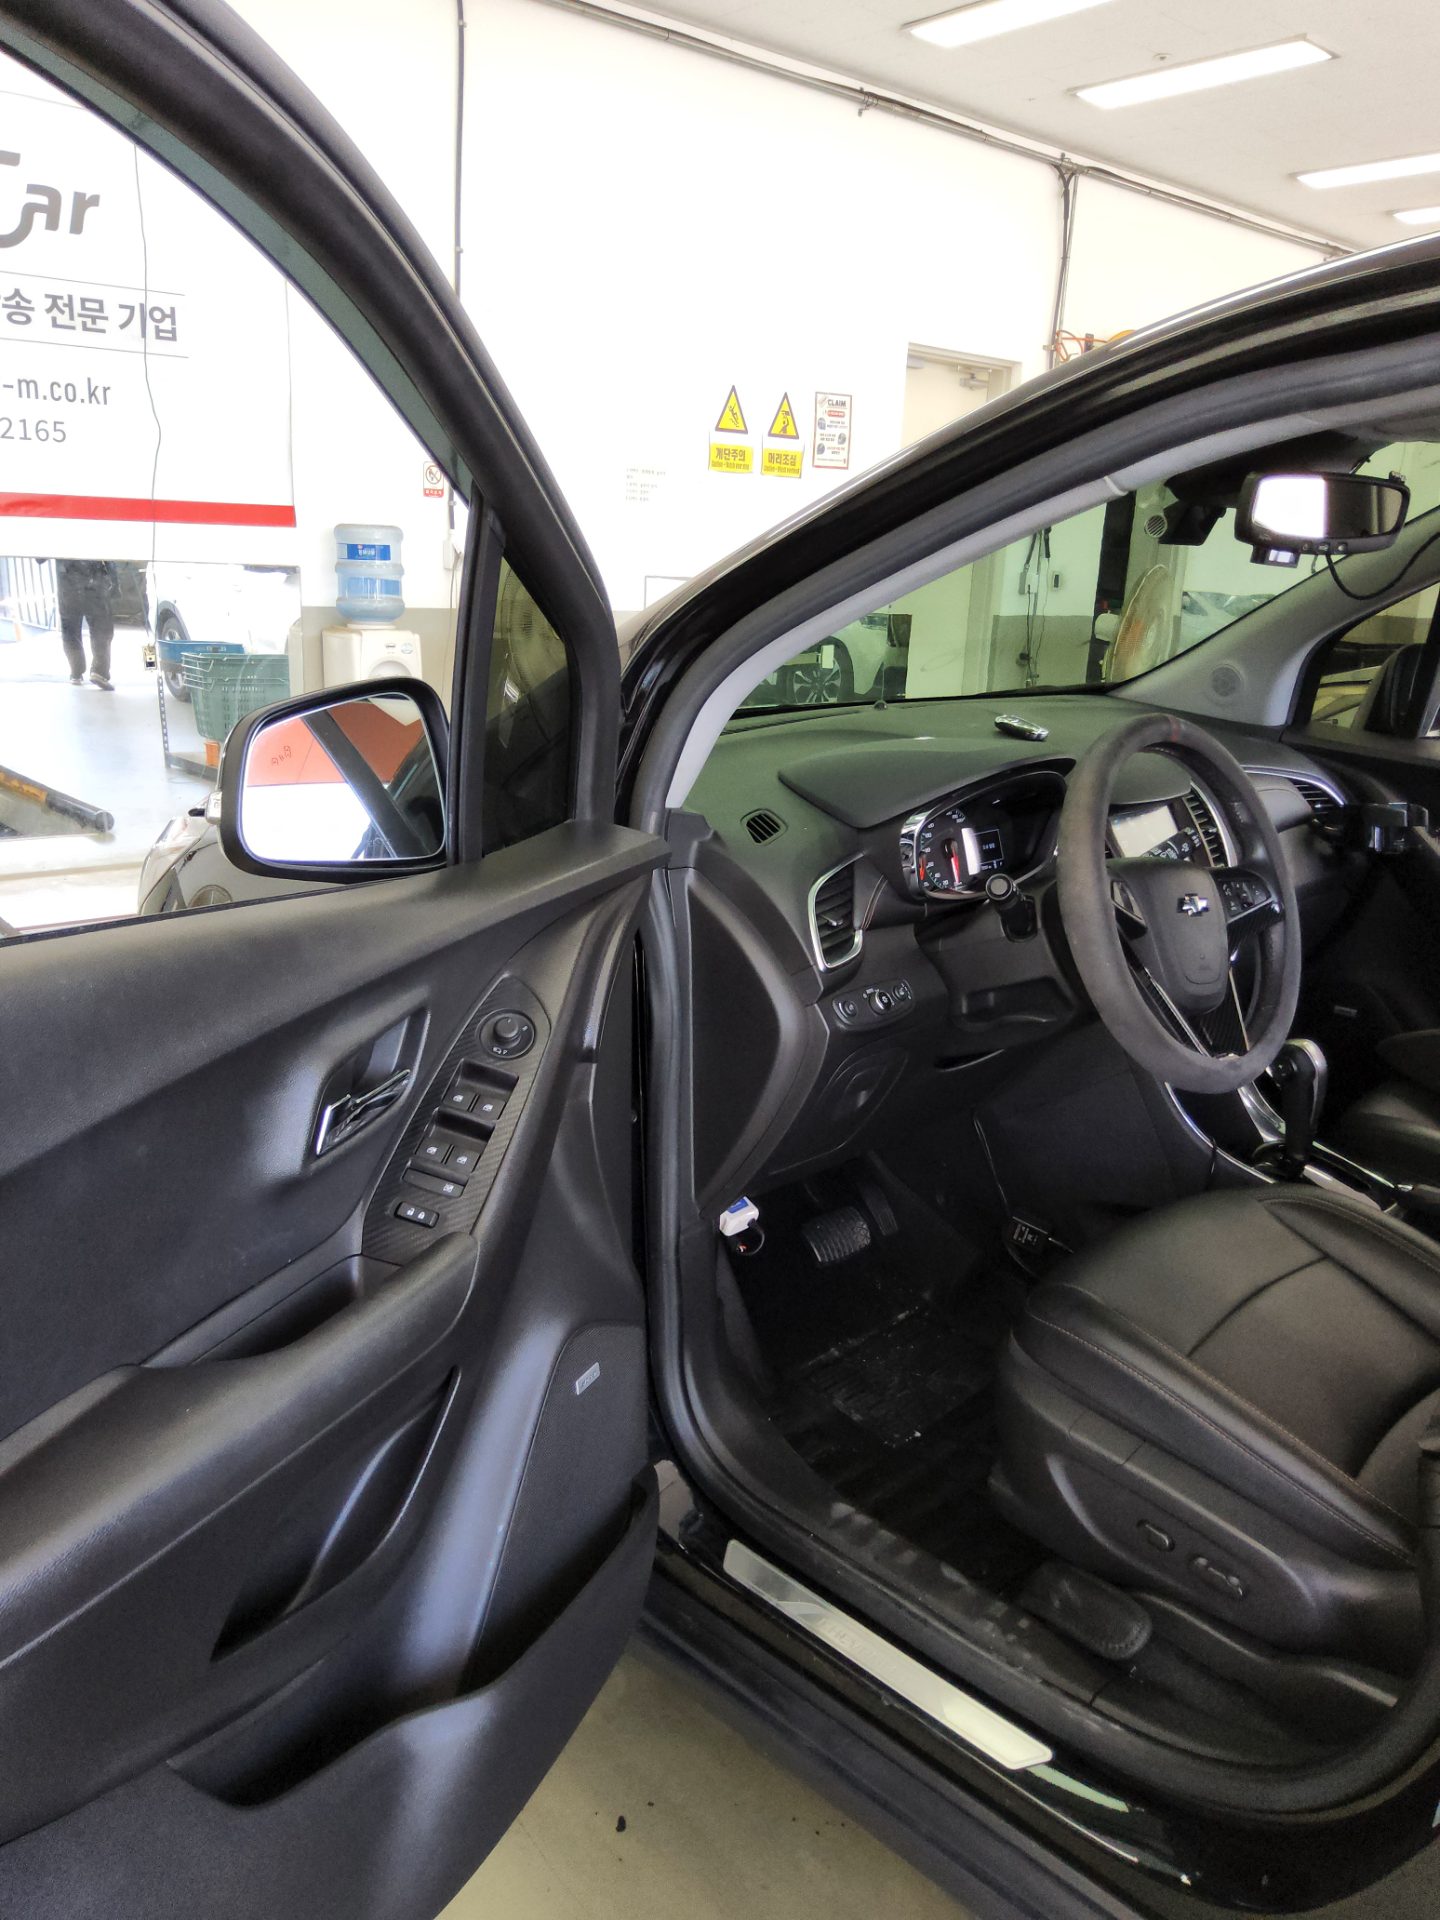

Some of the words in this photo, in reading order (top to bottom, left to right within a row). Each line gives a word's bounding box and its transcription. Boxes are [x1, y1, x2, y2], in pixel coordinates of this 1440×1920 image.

[0, 288, 35, 325] 송
[44, 293, 109, 334] 전문
[118, 302, 178, 342] 기업
[827, 399, 847, 407] CLAIM
[0, 416, 66, 443] 2165
[716, 447, 746, 462] 계단주의
[768, 452, 797, 467] 머리조심
